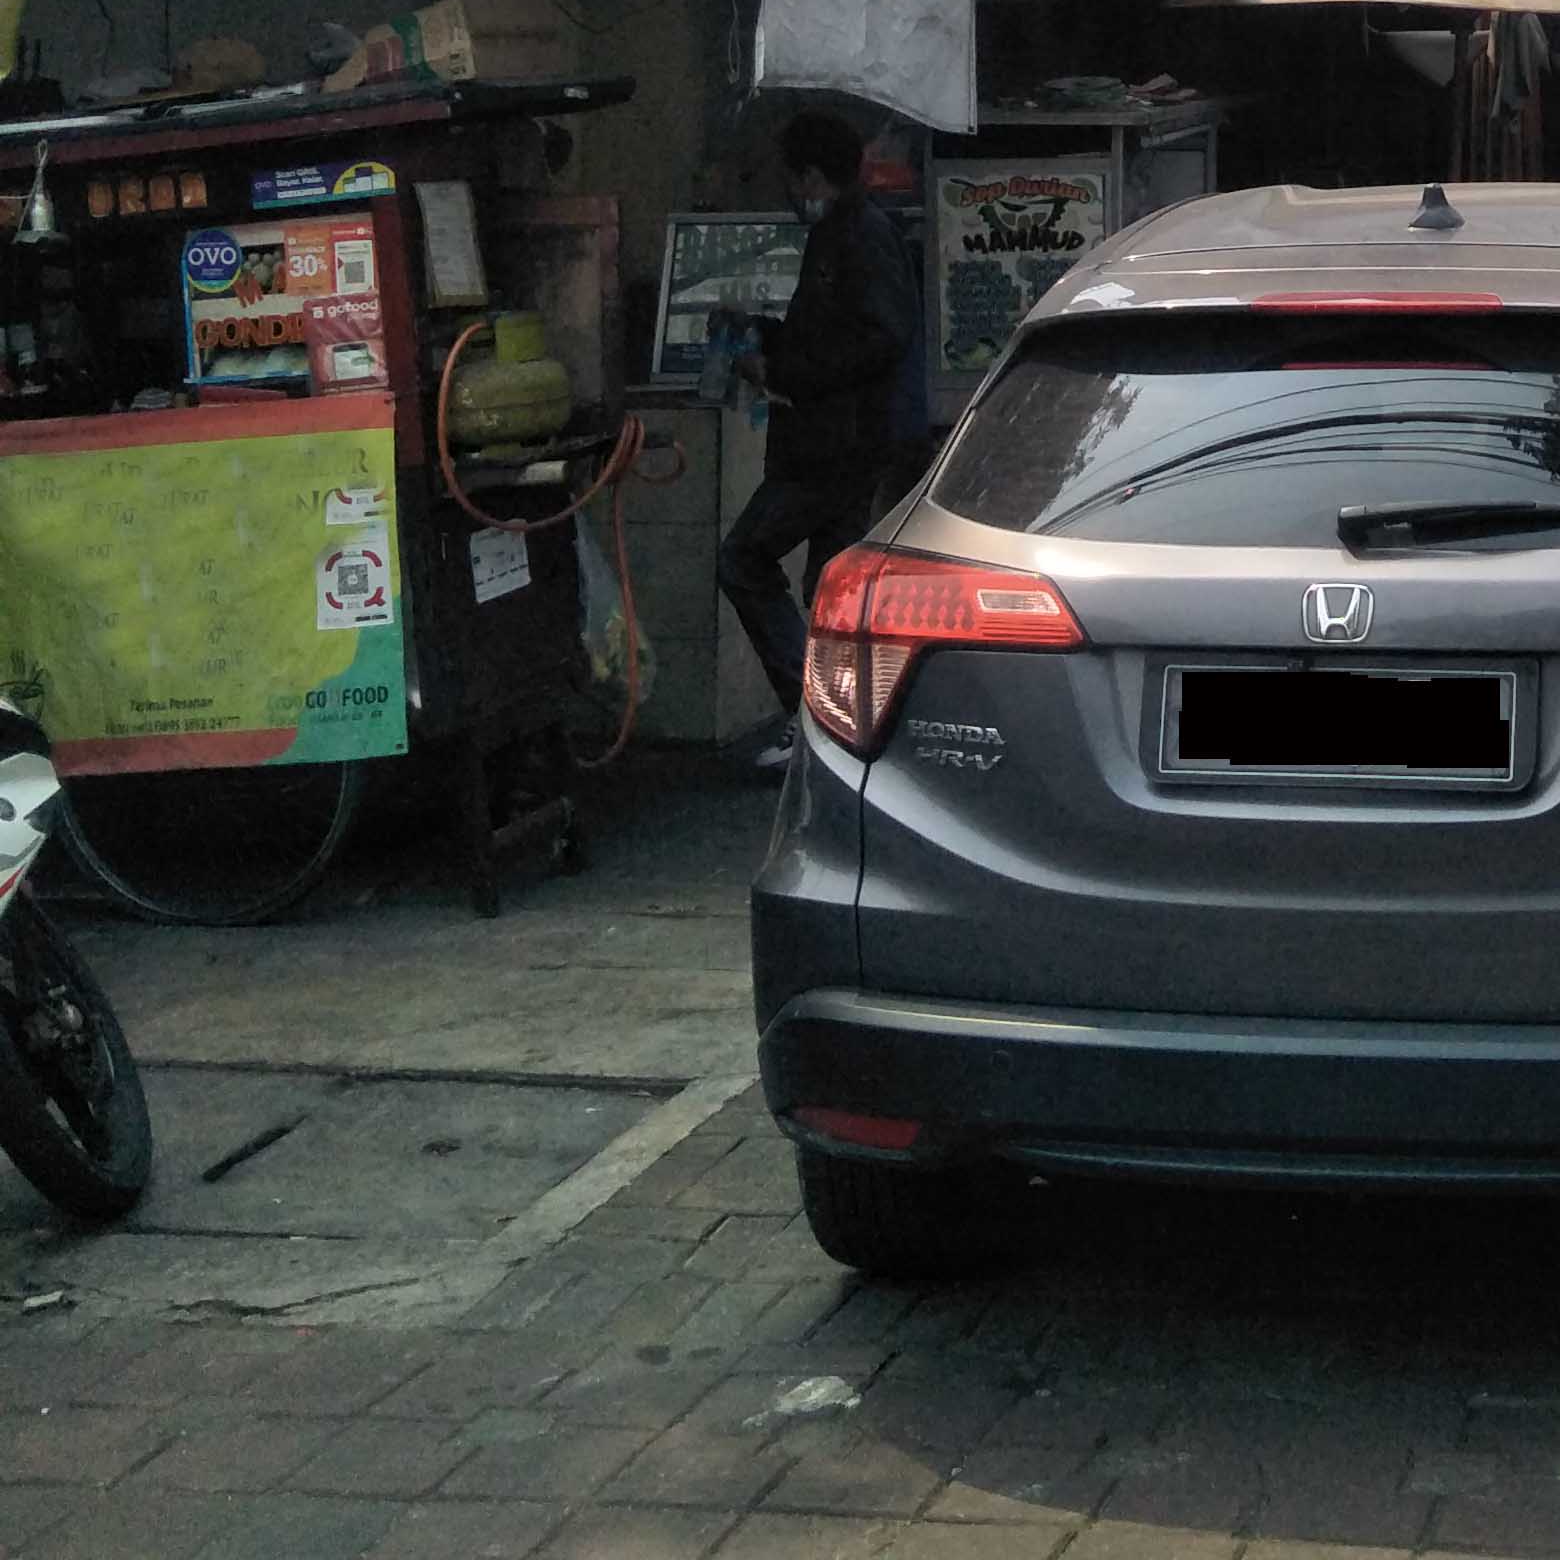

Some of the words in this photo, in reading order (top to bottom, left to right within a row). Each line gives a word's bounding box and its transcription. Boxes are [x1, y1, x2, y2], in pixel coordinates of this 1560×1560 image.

[187, 246, 238, 267] OVO
[342, 685, 389, 707] FOOD
[908, 719, 1007, 745] HONDA
[917, 746, 1003, 771] HR-V
